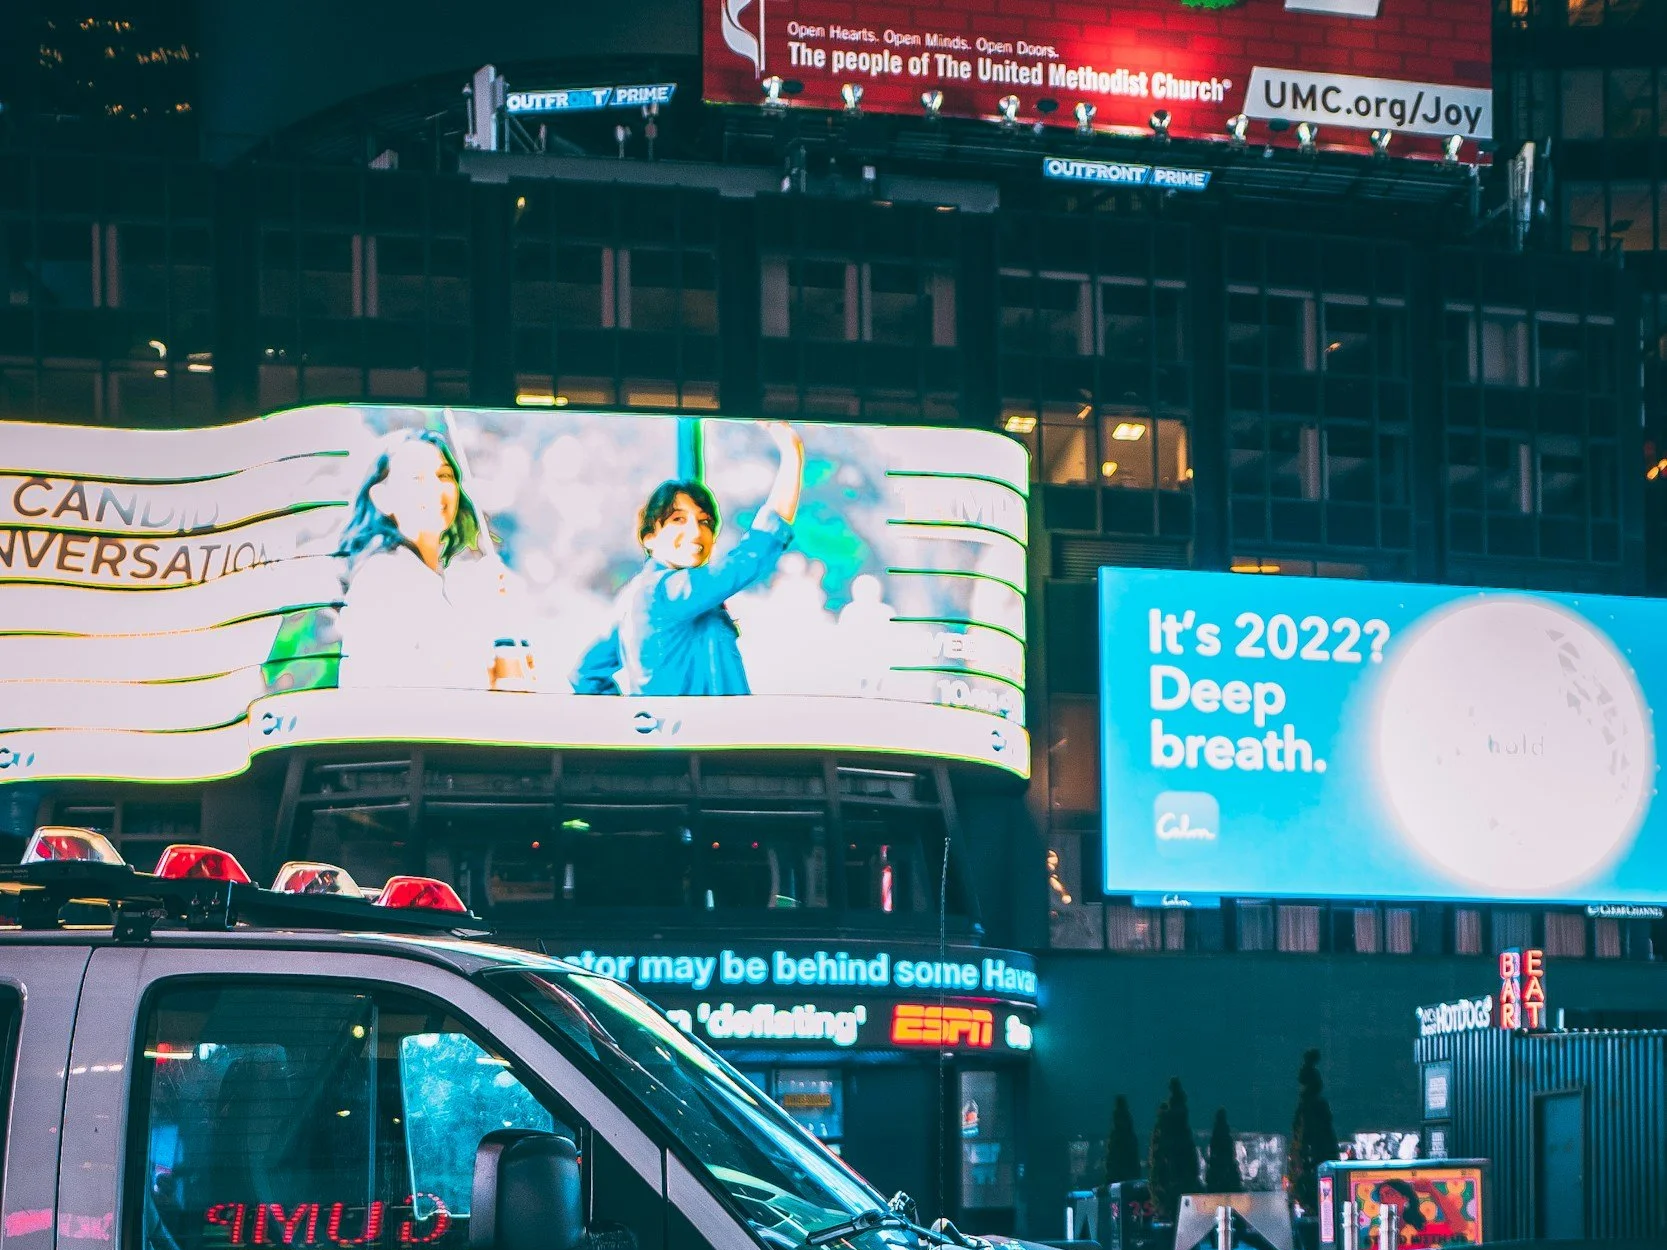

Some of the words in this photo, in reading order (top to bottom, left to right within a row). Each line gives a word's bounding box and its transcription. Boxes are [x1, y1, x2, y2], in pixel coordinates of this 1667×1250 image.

[786, 21, 825, 38] Open
[829, 25, 879, 42] Hearts.
[883, 29, 921, 46] Open
[925, 33, 971, 50] Minds.
[976, 37, 1012, 54] Open
[1016, 41, 1059, 57] Doors.
[787, 41, 826, 67] The
[831, 49, 903, 76] people
[908, 52, 930, 76] of
[934, 53, 972, 78] The
[977, 57, 1043, 85] United
[1048, 63, 1149, 96] Methodist
[507, 91, 608, 111] OUTFRT
[616, 87, 669, 102] PRIME
[1264, 79, 1482, 134] UMC.org/Joy
[1049, 160, 1146, 181] OUTFRONT
[1154, 169, 1205, 186] PRIME
[1148, 608, 1222, 656] It's
[1234, 611, 1391, 664] 2022?
[1149, 663, 1286, 728] Deep
[1150, 718, 1327, 773] breath.
[1487, 733, 1544, 756] hold
[1156, 812, 1216, 841] Calm
[564, 951, 635, 981] tor
[639, 956, 717, 989] may
[720, 950, 769, 984] be
[773, 951, 890, 986] behind
[894, 960, 980, 989] some
[1500, 952, 1516, 1030] BAR
[1522, 949, 1544, 1029] EAT
[892, 1004, 993, 1047] ESPN
